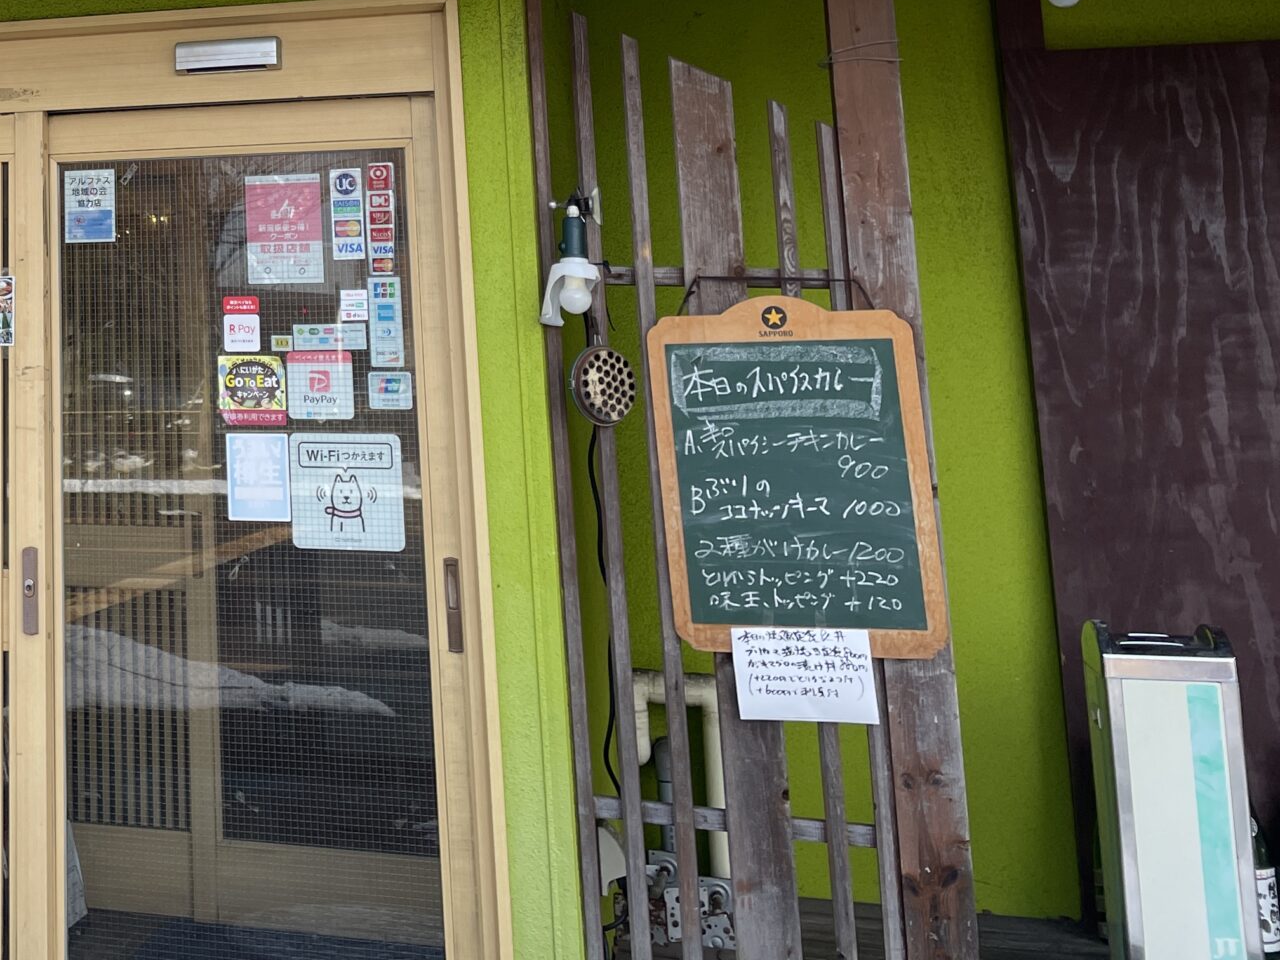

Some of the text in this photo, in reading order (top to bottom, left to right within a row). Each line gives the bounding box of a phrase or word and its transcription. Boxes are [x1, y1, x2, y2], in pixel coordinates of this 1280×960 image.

[336, 177, 356, 190] UC
[371, 194, 390, 207] DC
[337, 243, 363, 253] VISA
[373, 246, 394, 254] VISA
[682, 364, 874, 401] 本日のスパイスカレー
[236, 390, 269, 398] キャンペーン
[303, 395, 338, 405] PayPay
[838, 455, 889, 479] 900
[842, 499, 901, 519] 1000
[848, 541, 905, 563] 1200
[840, 571, 899, 587] +220
[844, 596, 902, 611] +120
